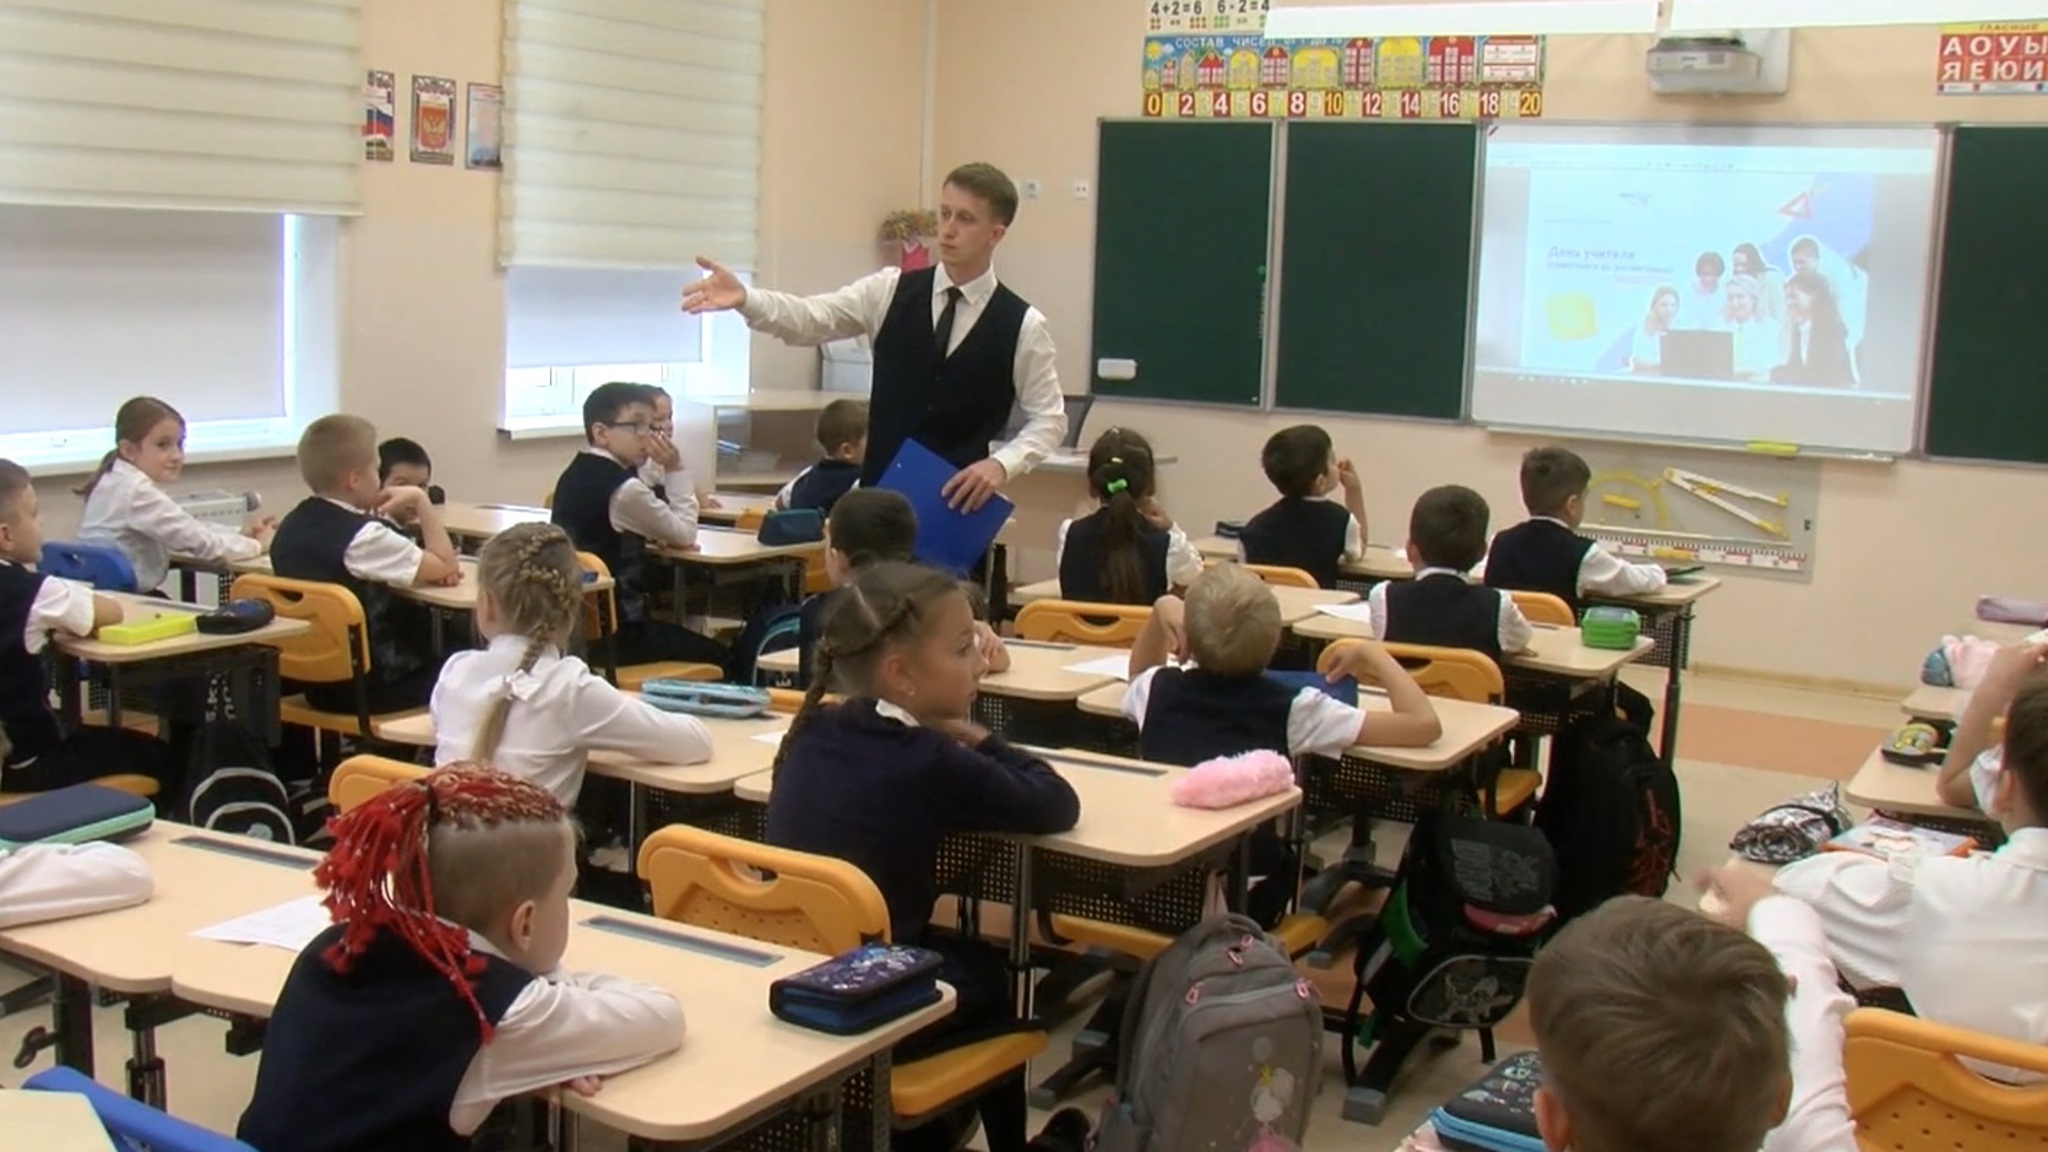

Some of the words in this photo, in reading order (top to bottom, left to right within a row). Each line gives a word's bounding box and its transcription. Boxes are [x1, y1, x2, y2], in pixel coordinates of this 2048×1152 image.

[1175, 37, 1225, 48] СОСТАВ
[1148, 93, 1160, 114] 0
[1181, 93, 1194, 114] 2
[1215, 93, 1228, 114] 4
[1252, 93, 1266, 114] 6
[1291, 93, 1304, 114] 8
[1324, 93, 1342, 114] 10
[1364, 93, 1381, 114] 12
[1402, 93, 1419, 114] 14
[1441, 93, 1459, 114] 16
[1481, 93, 1499, 114] 18
[1521, 93, 1540, 114] 20
